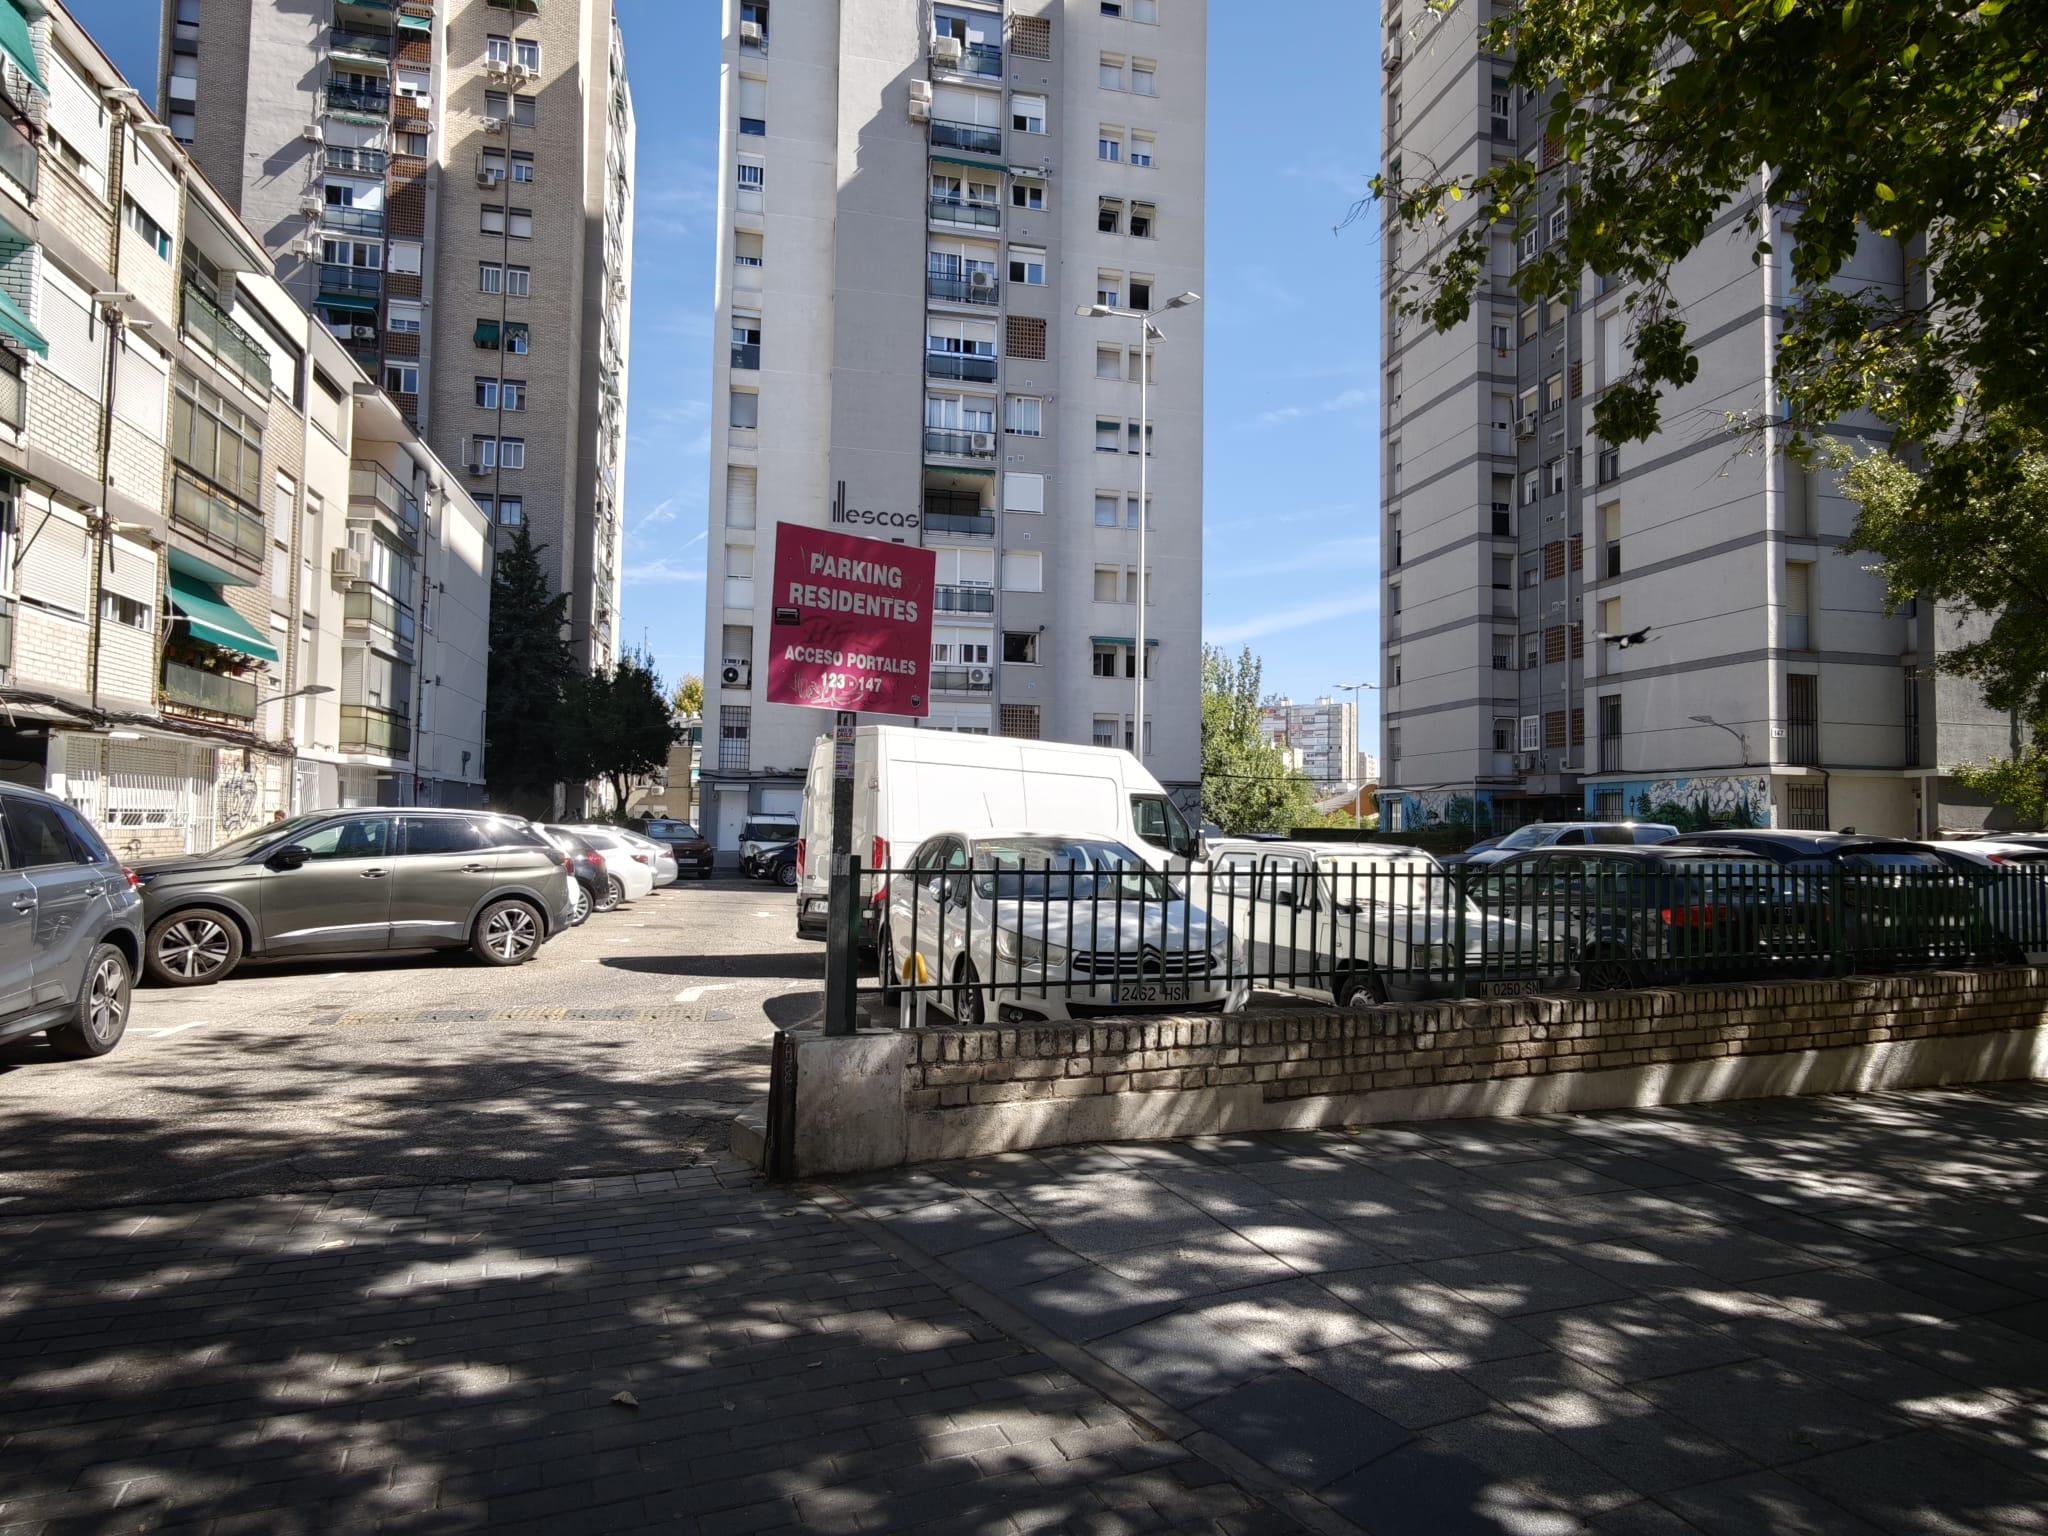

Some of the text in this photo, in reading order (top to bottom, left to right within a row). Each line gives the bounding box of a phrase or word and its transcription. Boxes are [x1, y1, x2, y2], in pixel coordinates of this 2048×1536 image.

[810, 553, 902, 588] PARKING
[789, 583, 918, 622] RESIDENTES
[785, 645, 916, 675] ACCESO PORTALES
[821, 672, 845, 689] 123
[858, 677, 882, 693] 147
[1121, 986, 1190, 1001] 2462 HSN
